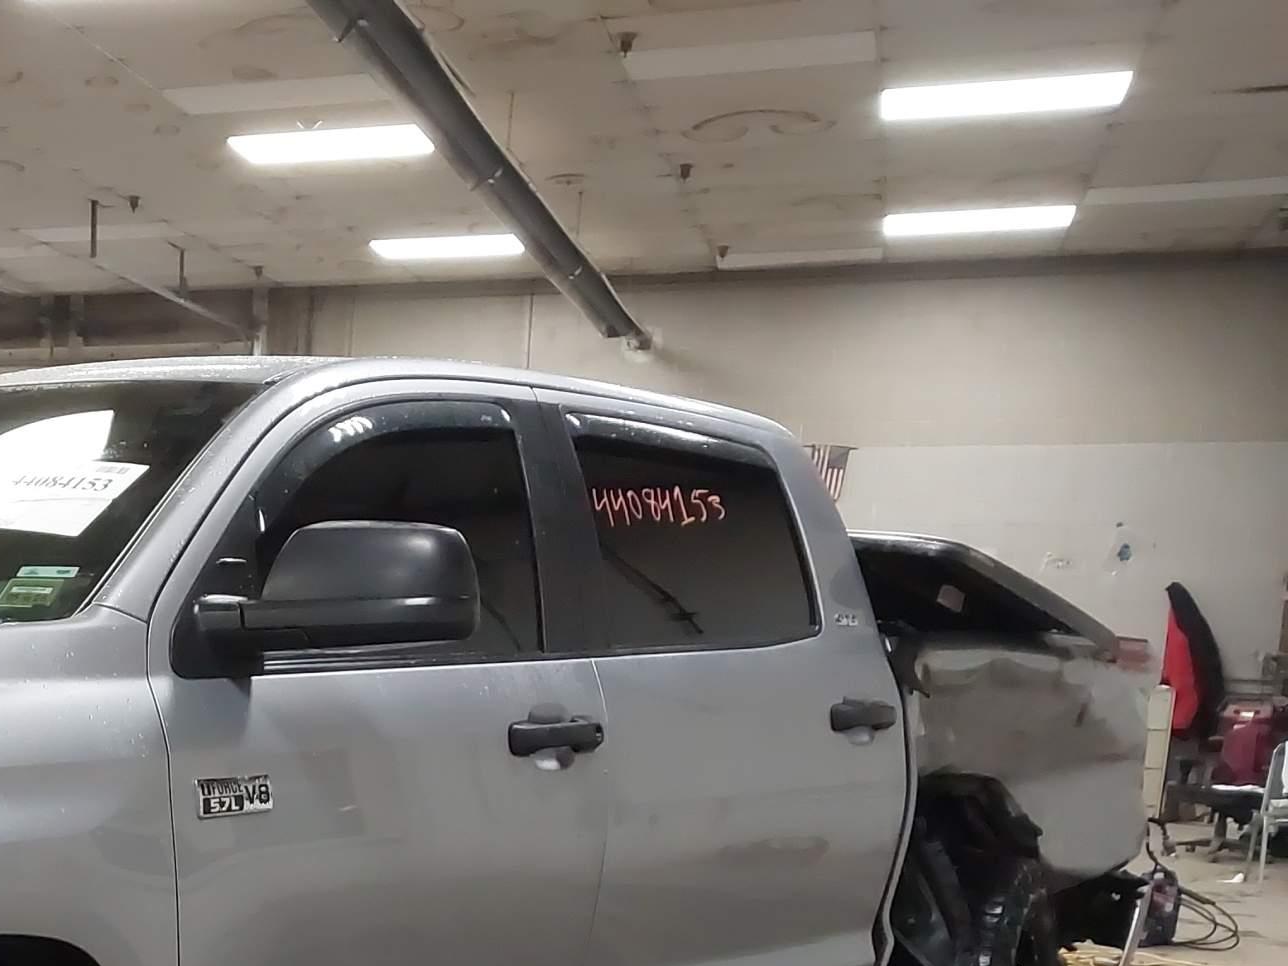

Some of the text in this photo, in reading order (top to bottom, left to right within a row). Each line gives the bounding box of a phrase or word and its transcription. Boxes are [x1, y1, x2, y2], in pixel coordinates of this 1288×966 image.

[12, 475, 113, 492] 44084153
[591, 485, 726, 527] 44084153
[244, 783, 271, 804] V8
